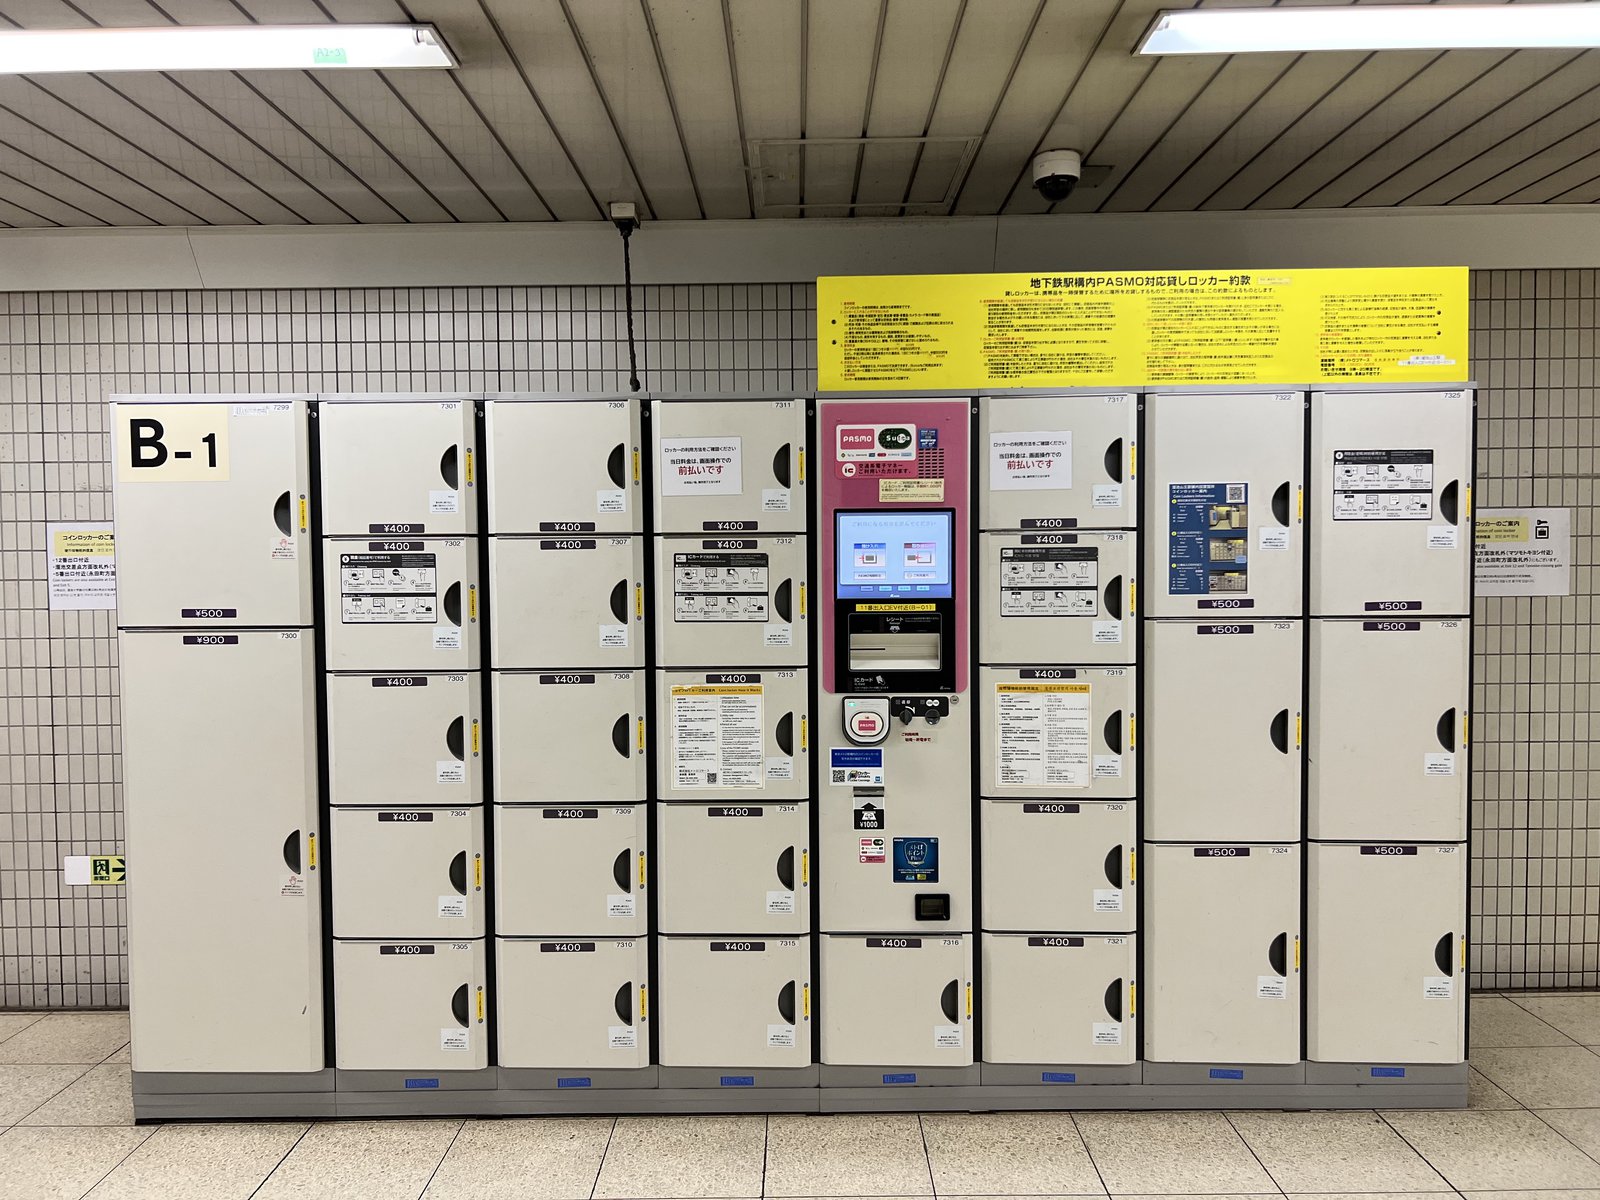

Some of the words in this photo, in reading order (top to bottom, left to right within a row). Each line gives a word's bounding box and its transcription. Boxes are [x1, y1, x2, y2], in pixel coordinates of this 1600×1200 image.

[1030, 275, 1251, 288] 地下鉄駅構内PASMO対応貸しロッカー約款
[130, 418, 217, 468] B-1
[1007, 459, 1054, 470] 前払いです
[678, 465, 724, 475] 前払いです
[554, 522, 581, 531] ¥400
[717, 521, 744, 530] ¥400
[1035, 519, 1063, 528] ¥400
[383, 524, 411, 533] ¥400
[1035, 535, 1063, 544] ¥400
[383, 542, 410, 551] ¥400
[555, 540, 582, 549] ¥400
[717, 540, 744, 549] ¥400
[1211, 600, 1241, 609] ¥500
[1378, 601, 1408, 611] ¥500
[195, 609, 223, 618] ¥500
[1211, 625, 1240, 634] ¥500
[1377, 622, 1406, 631] ¥500
[196, 636, 225, 645] ¥900
[1034, 669, 1062, 678] ¥400
[386, 677, 413, 686] ¥400
[554, 675, 581, 684] ¥400
[720, 674, 747, 683] ¥400
[722, 807, 749, 816] ¥400
[1038, 804, 1065, 813] ¥400
[392, 812, 419, 821] ¥400
[557, 809, 584, 818] ¥400
[1207, 848, 1236, 857] ¥500
[1374, 846, 1404, 855] ¥500
[724, 942, 751, 951] ¥400
[880, 939, 907, 948] ¥400
[1042, 937, 1070, 947] ¥400
[394, 945, 421, 954] ¥400
[554, 943, 581, 952] ¥400
